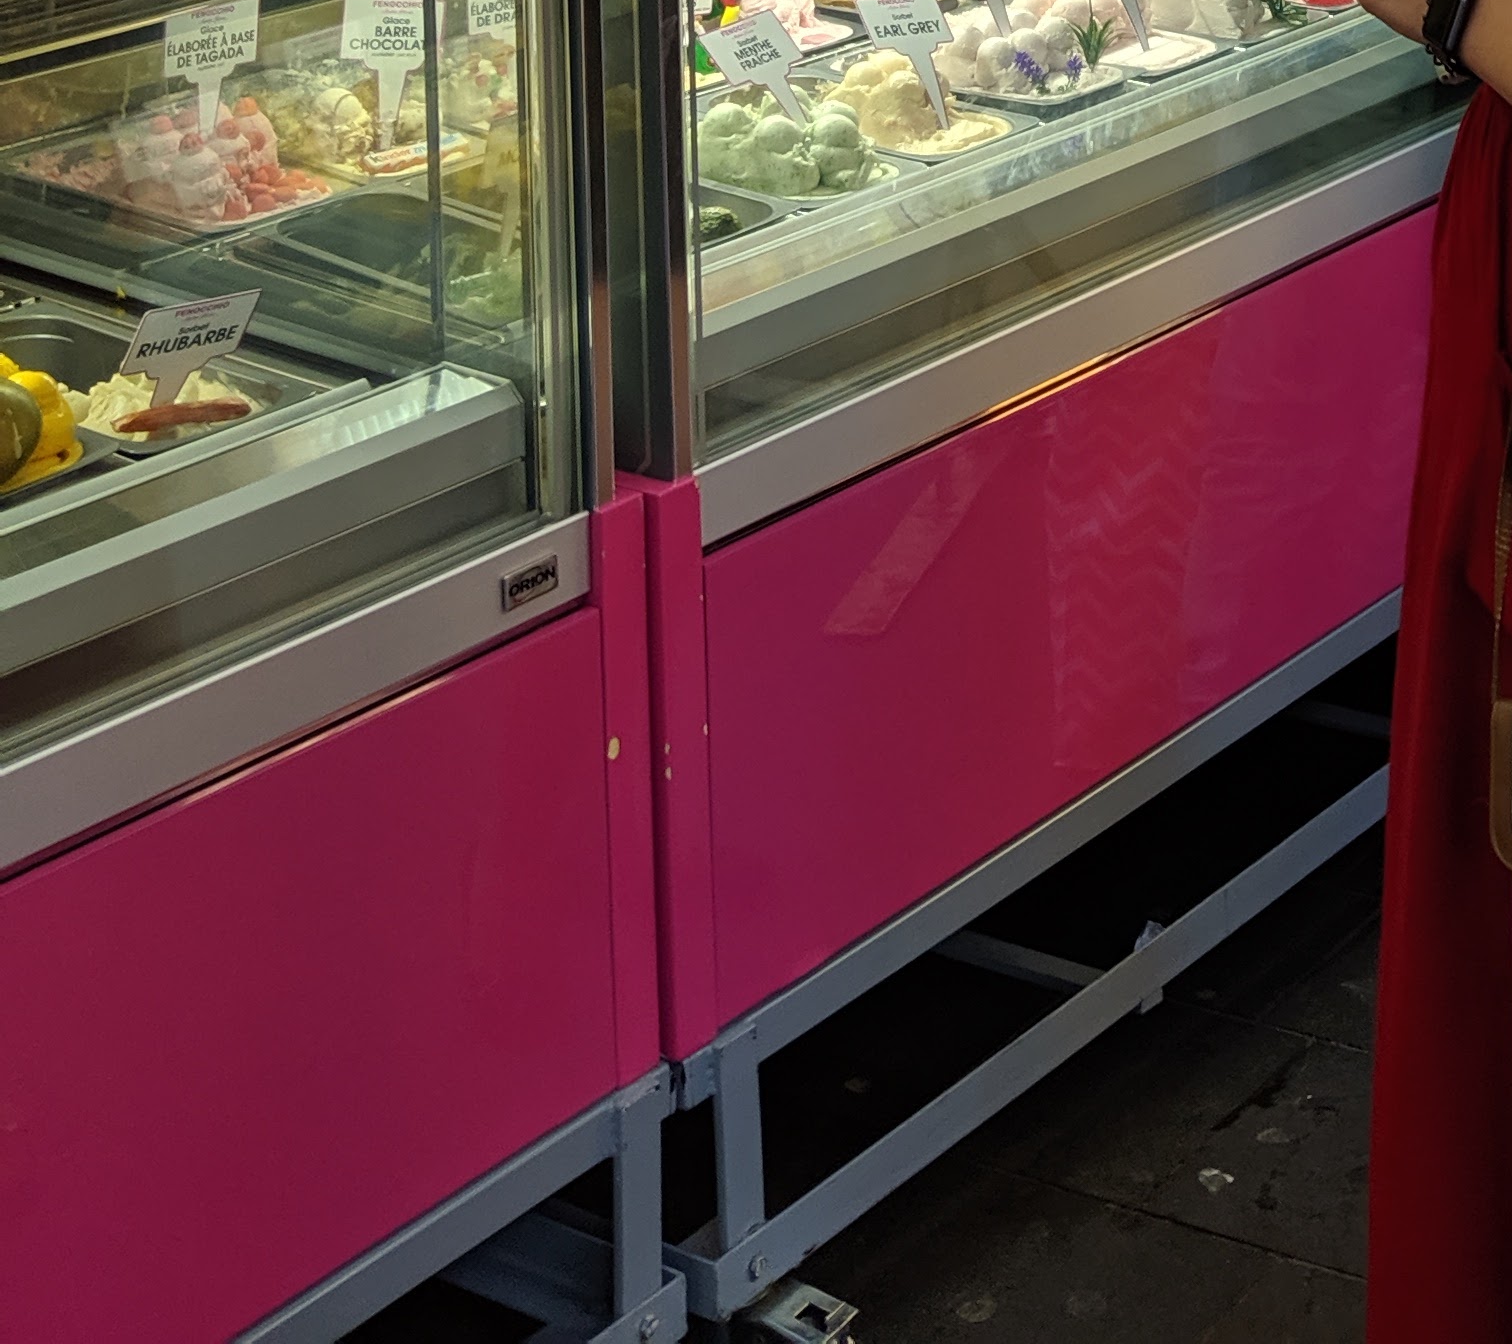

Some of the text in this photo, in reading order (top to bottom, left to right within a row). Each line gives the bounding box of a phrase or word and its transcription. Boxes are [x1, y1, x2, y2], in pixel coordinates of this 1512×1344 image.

[382, 16, 410, 25] Glace
[874, 20, 940, 38] EARL GREY
[375, 26, 417, 38] BARRE
[167, 35, 218, 57] ÉLABORÉE
[230, 30, 255, 44] BASE
[734, 38, 773, 60] MENTHE
[177, 46, 244, 68] DE TAGADA
[136, 324, 239, 358] RHUBARBE
[509, 566, 555, 597] ORION
